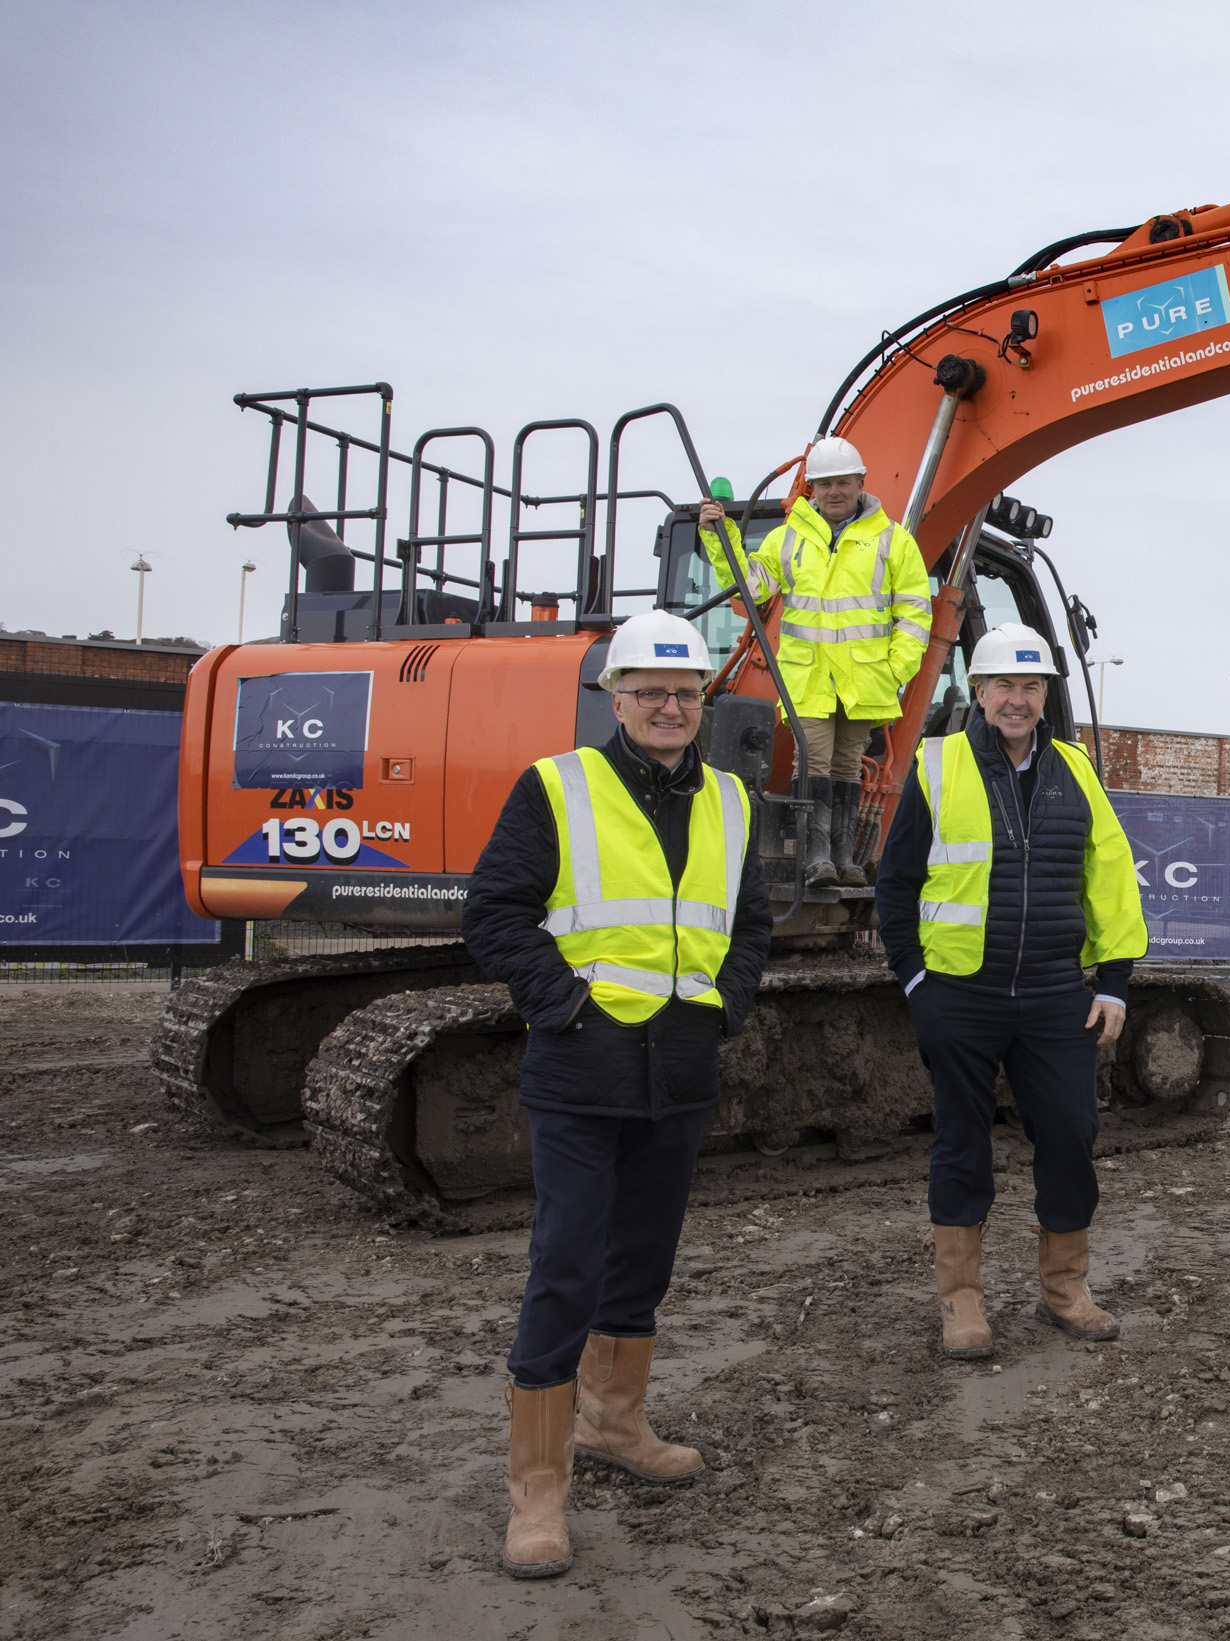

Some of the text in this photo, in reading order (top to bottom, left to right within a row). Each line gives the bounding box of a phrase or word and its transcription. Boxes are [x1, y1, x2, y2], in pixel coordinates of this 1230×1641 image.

[1118, 297, 1213, 340] PURE
[270, 788, 354, 811] ZAXIS
[1139, 892, 1220, 903] TRUCTION
